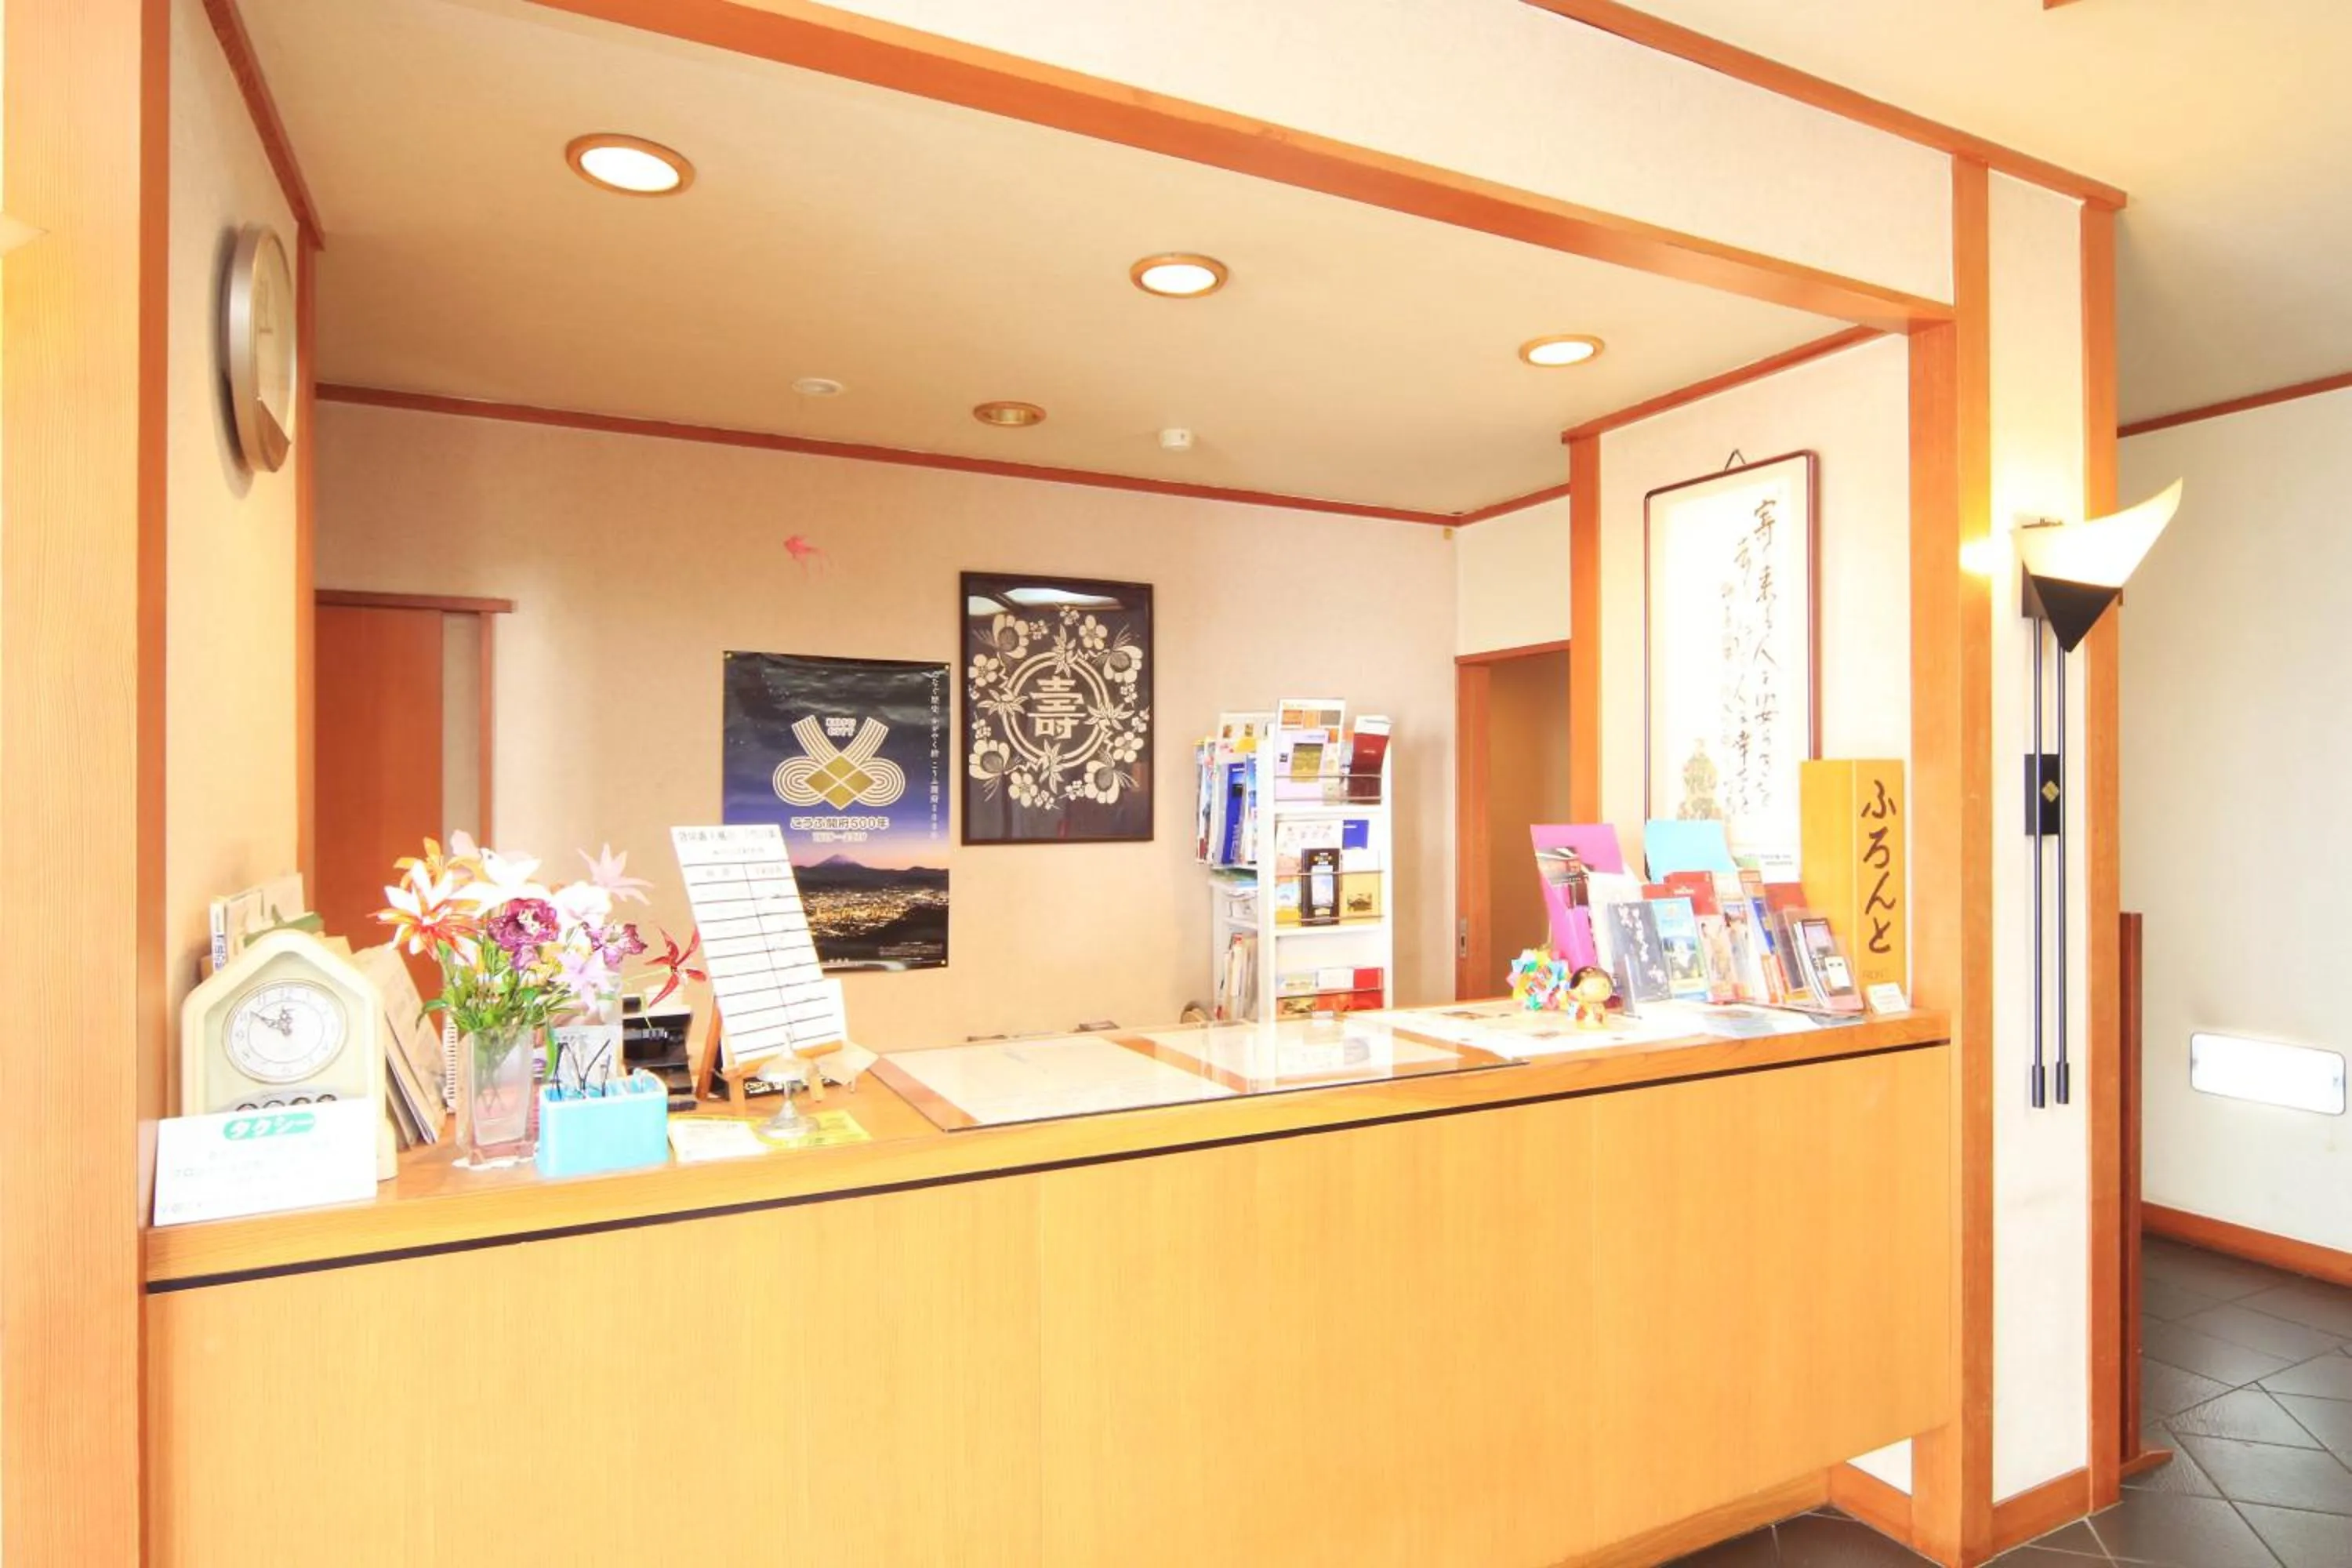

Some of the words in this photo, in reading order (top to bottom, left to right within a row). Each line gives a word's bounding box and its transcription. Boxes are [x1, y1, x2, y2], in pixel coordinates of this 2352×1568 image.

[790, 816, 890, 829] こうふ開府500年
[1860, 779, 1897, 953] ふろんと
[230, 1115, 315, 1138] タクシー
